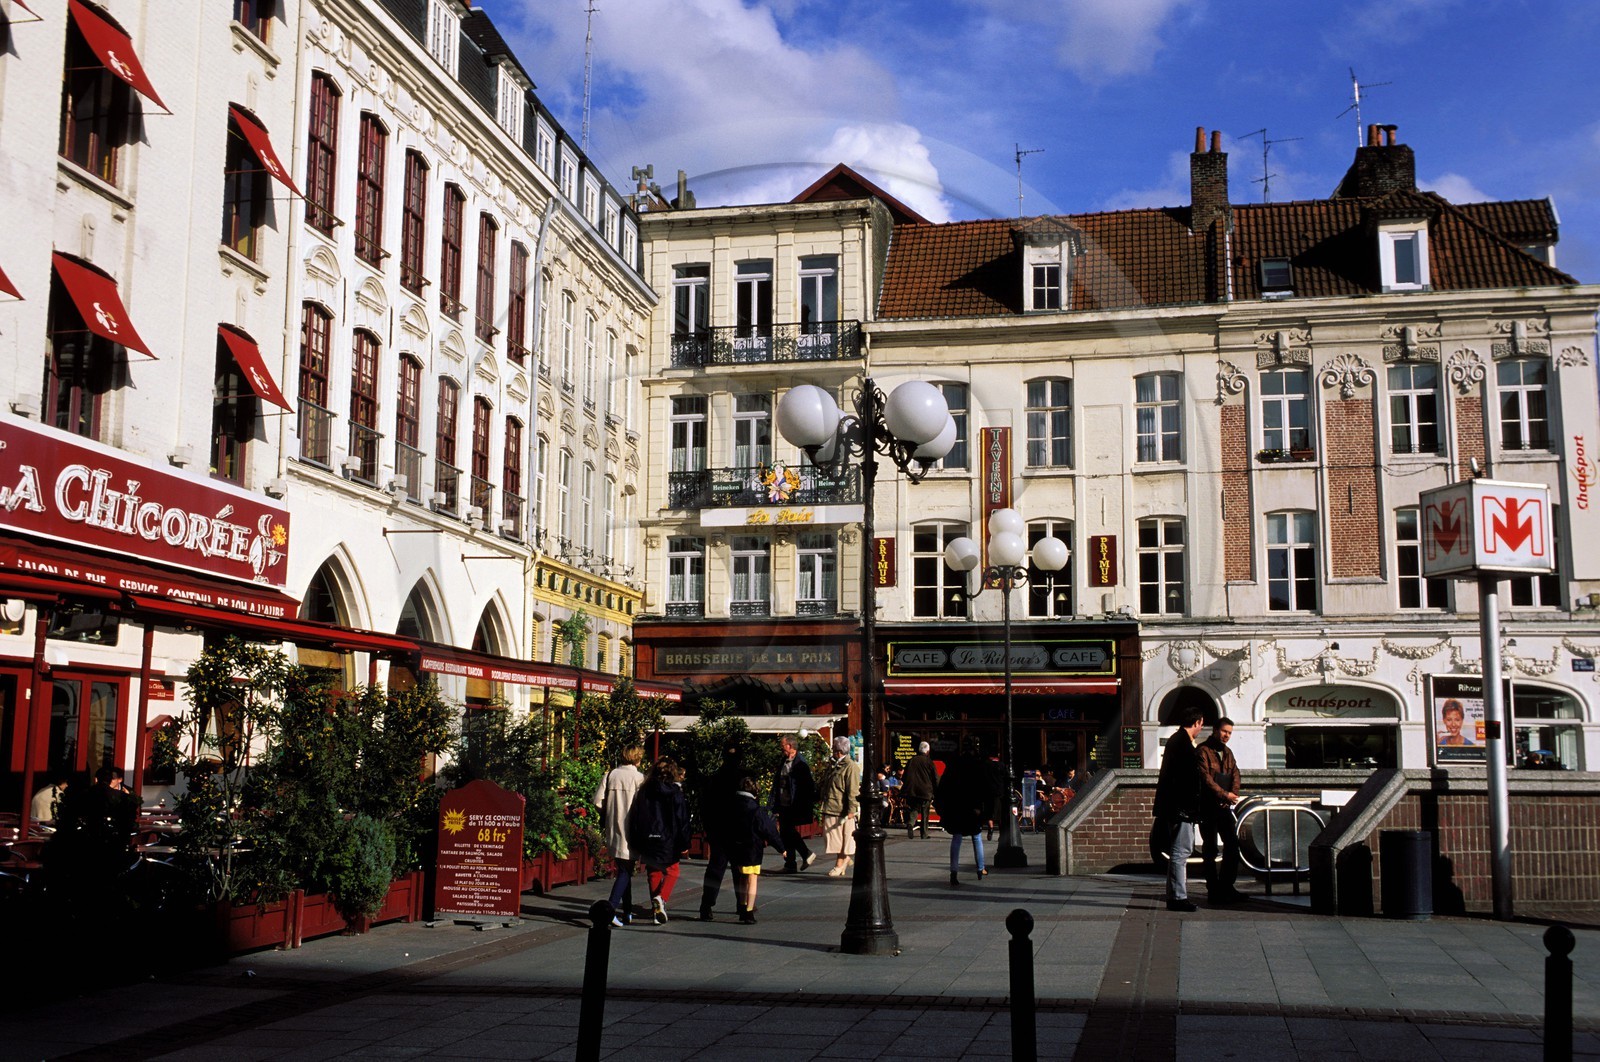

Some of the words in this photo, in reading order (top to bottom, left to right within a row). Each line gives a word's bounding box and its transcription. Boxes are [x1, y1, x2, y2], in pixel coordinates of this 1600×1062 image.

[990, 428, 1002, 502] TAVERNE
[1574, 435, 1588, 510] Chausport
[748, 509, 770, 523] La
[777, 508, 814, 523] Paix
[878, 539, 888, 584] PRIMUS
[1099, 537, 1110, 583] PRIMUS
[665, 653, 744, 665] BRASSERIE
[777, 653, 793, 663] LA
[802, 652, 832, 663] PAIX
[902, 653, 939, 664] CAFE
[956, 650, 976, 665] Le
[1059, 651, 1098, 663] CAFE
[1288, 695, 1371, 711] Chausport
[936, 711, 955, 720] BAR
[1048, 708, 1075, 720] CAFE
[478, 828, 490, 842] 68
